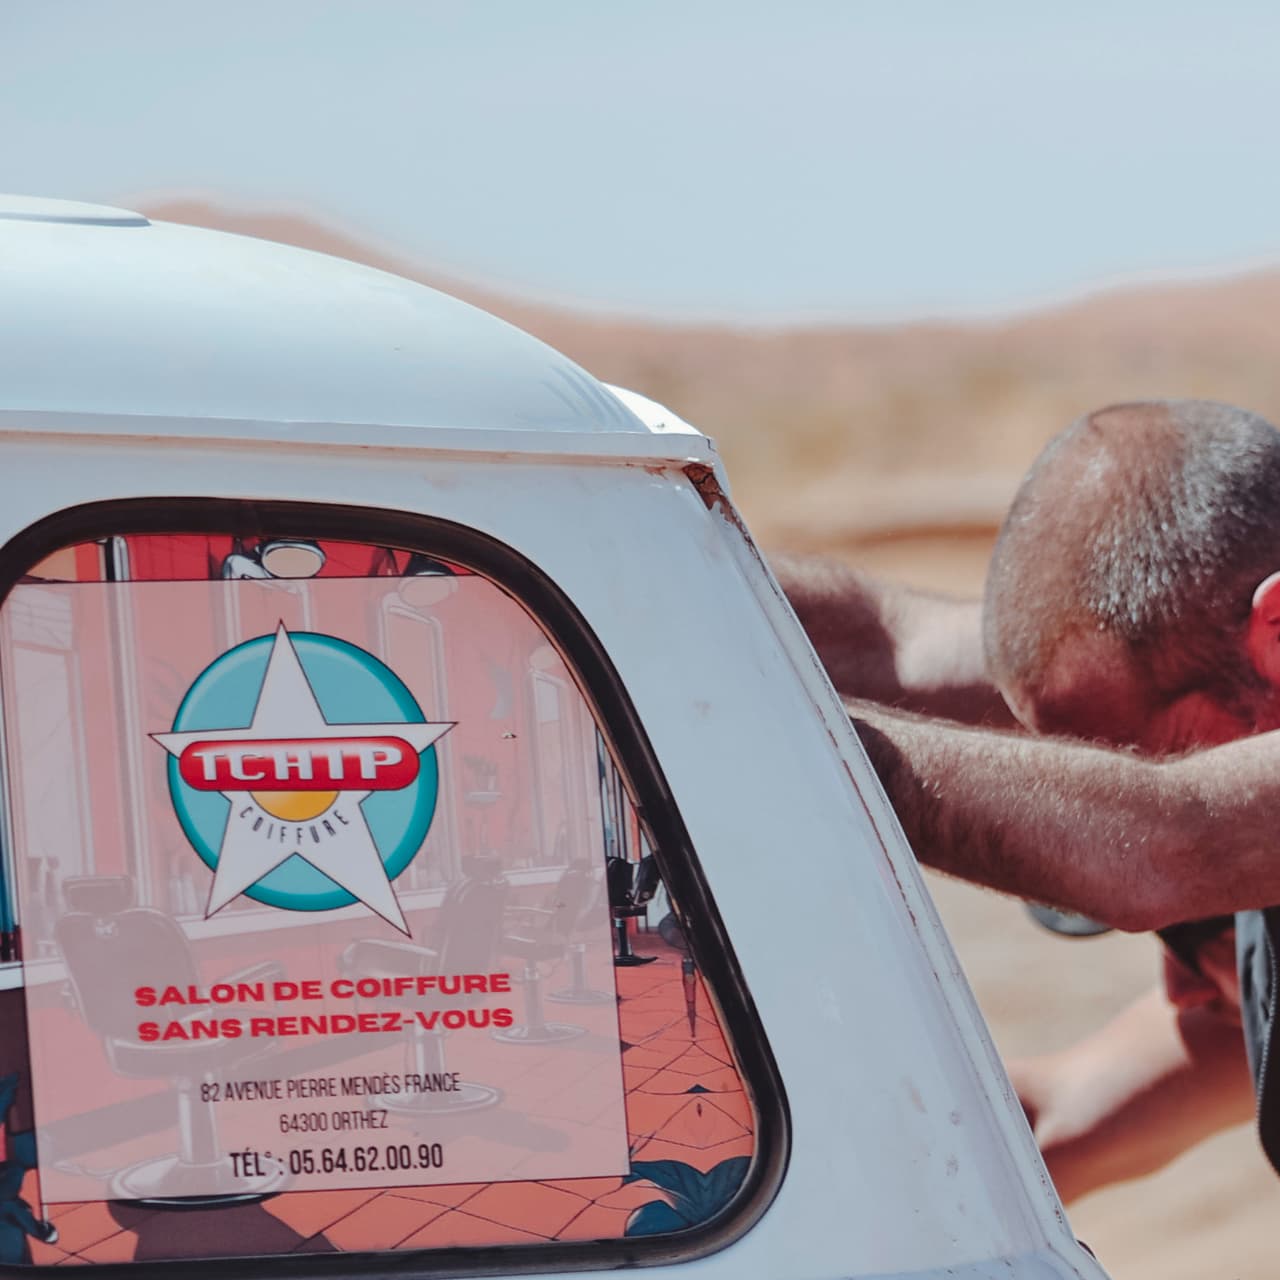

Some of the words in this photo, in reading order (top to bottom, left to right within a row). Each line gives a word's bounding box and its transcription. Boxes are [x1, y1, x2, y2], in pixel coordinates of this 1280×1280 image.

[191, 748, 403, 781] TCHIP
[239, 806, 349, 844] COIFFURE
[134, 983, 267, 1007] SALON
[271, 981, 324, 1001] DE
[330, 973, 512, 999] COIFFURE
[137, 1021, 244, 1042] SANS
[249, 1009, 514, 1037] RENDEZ-VOUS
[201, 1083, 219, 1102] 82
[224, 1080, 282, 1100] AVENUE
[287, 1077, 336, 1098] PIERRE
[341, 1072, 401, 1096] MENDÈS
[404, 1072, 461, 1093] FRANCE
[280, 1112, 328, 1132] 64300
[332, 1109, 388, 1130] ORTHEZ
[290, 1143, 443, 1175] 05.64.62.00.90
